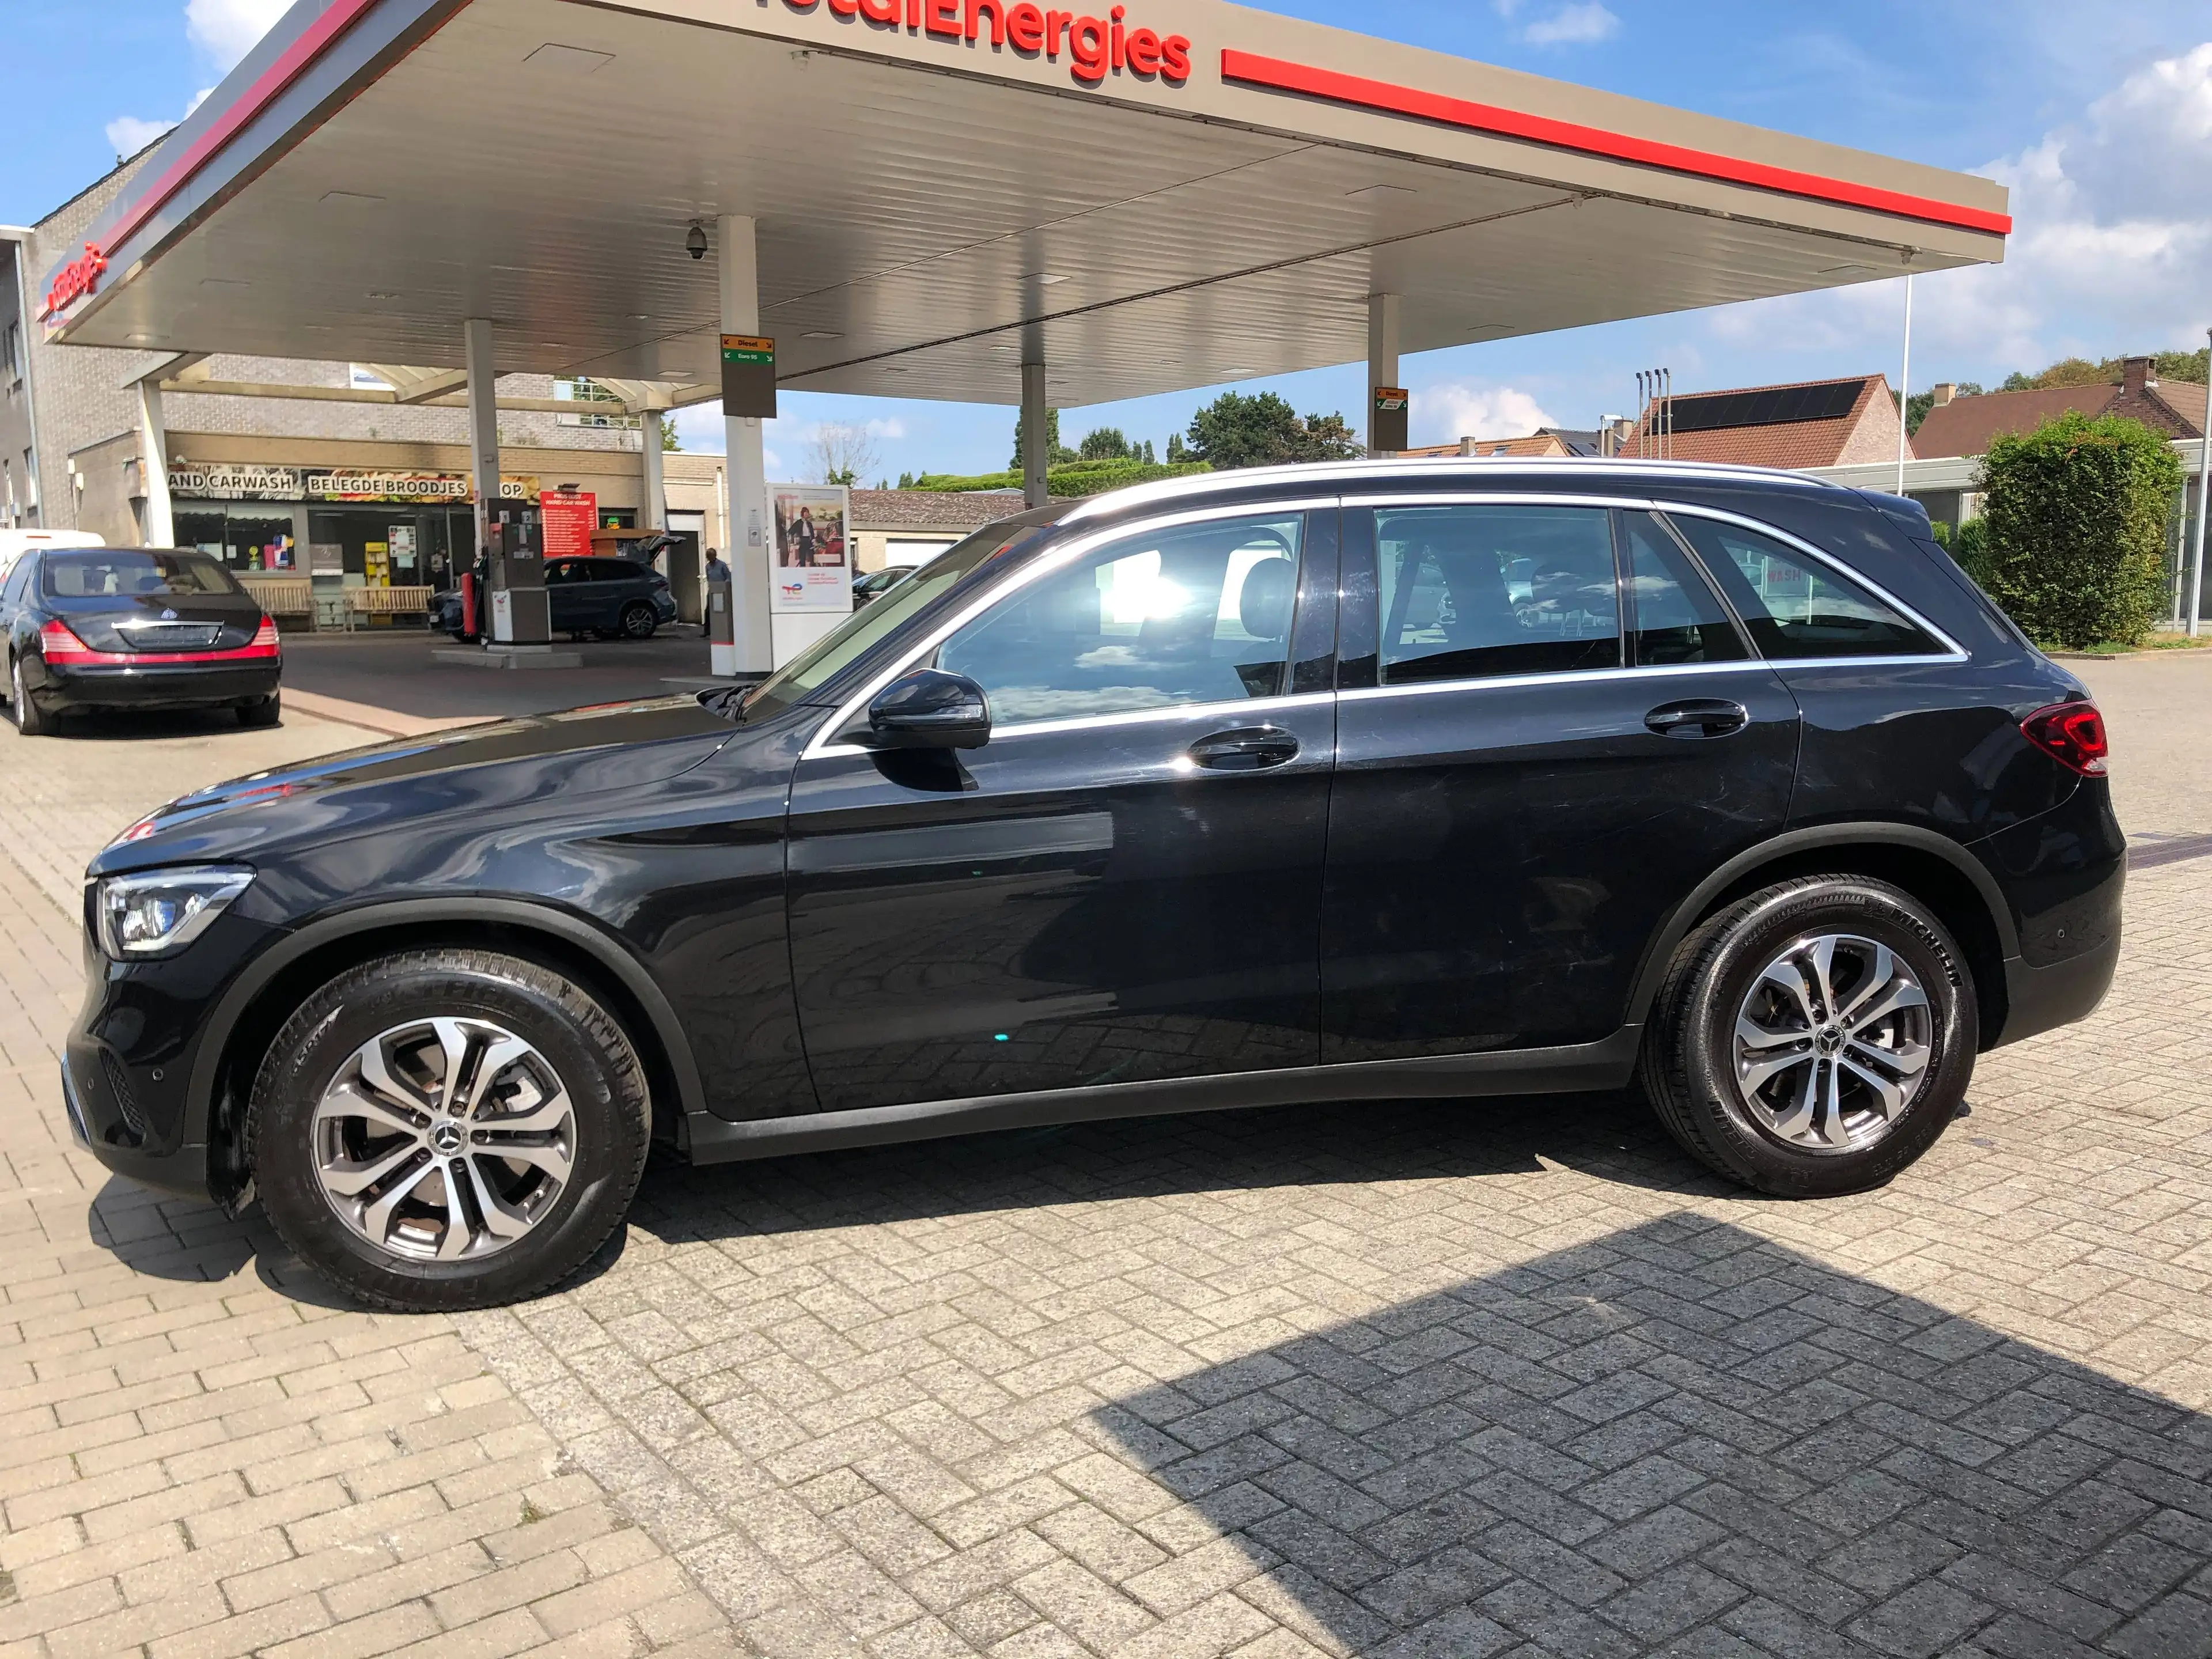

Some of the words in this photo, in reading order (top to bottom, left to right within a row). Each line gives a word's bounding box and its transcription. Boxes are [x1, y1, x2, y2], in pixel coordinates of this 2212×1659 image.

[785, 0, 1191, 80] Energies
[169, 475, 203, 486] AND
[209, 475, 291, 489] CARWASH
[311, 477, 381, 492] BELEGDE
[386, 480, 467, 495] BROODJES
[1768, 569, 1801, 582] WASH
[1889, 908, 1963, 987] MICHELIN
